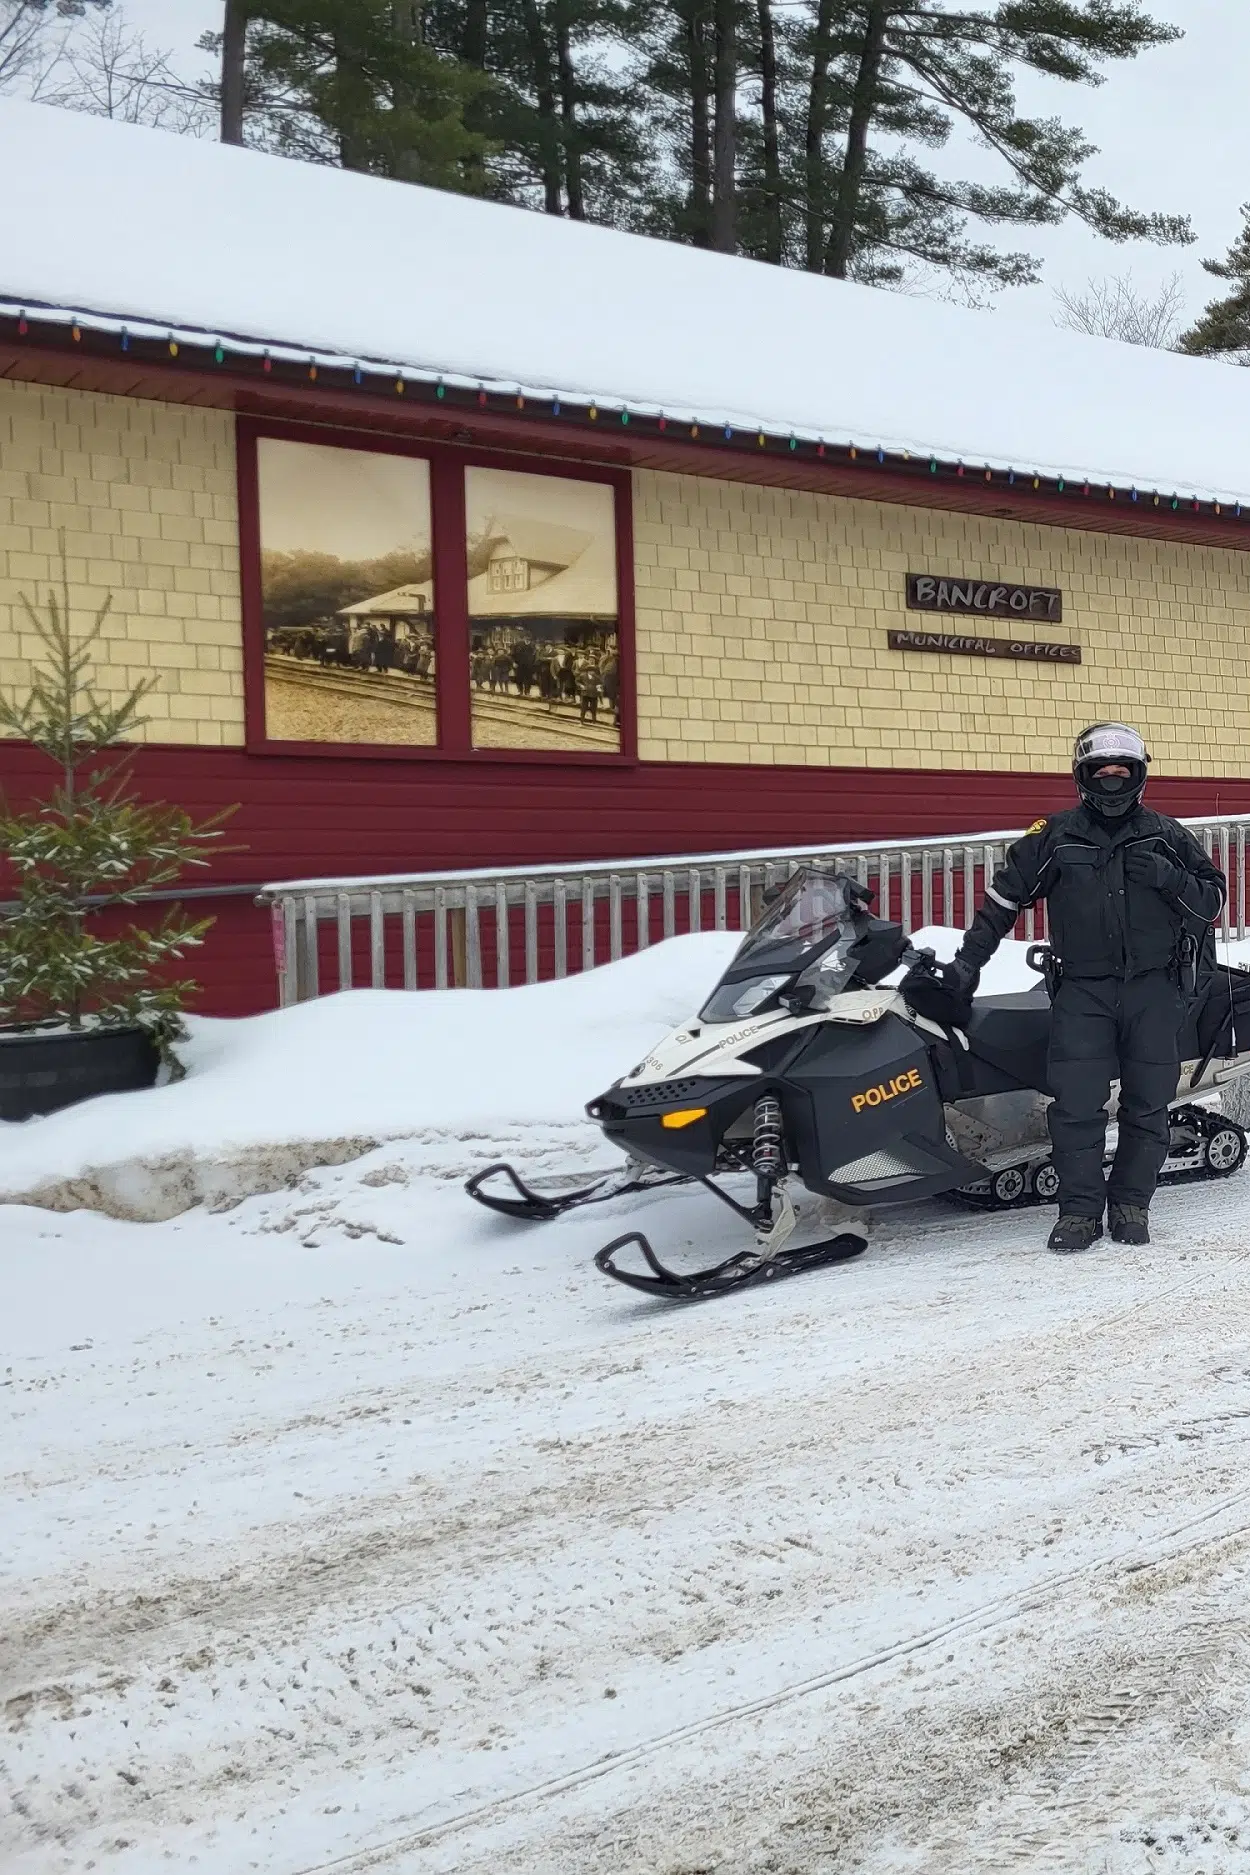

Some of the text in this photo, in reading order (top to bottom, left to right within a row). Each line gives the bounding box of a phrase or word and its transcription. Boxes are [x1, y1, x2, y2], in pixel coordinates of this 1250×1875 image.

[915, 576, 1059, 614] BANCROFT
[896, 631, 996, 654] MUNICIPAL
[718, 1025, 759, 1049] POLICE
[646, 1056, 664, 1071] 306
[851, 1068, 923, 1113] POLICE
